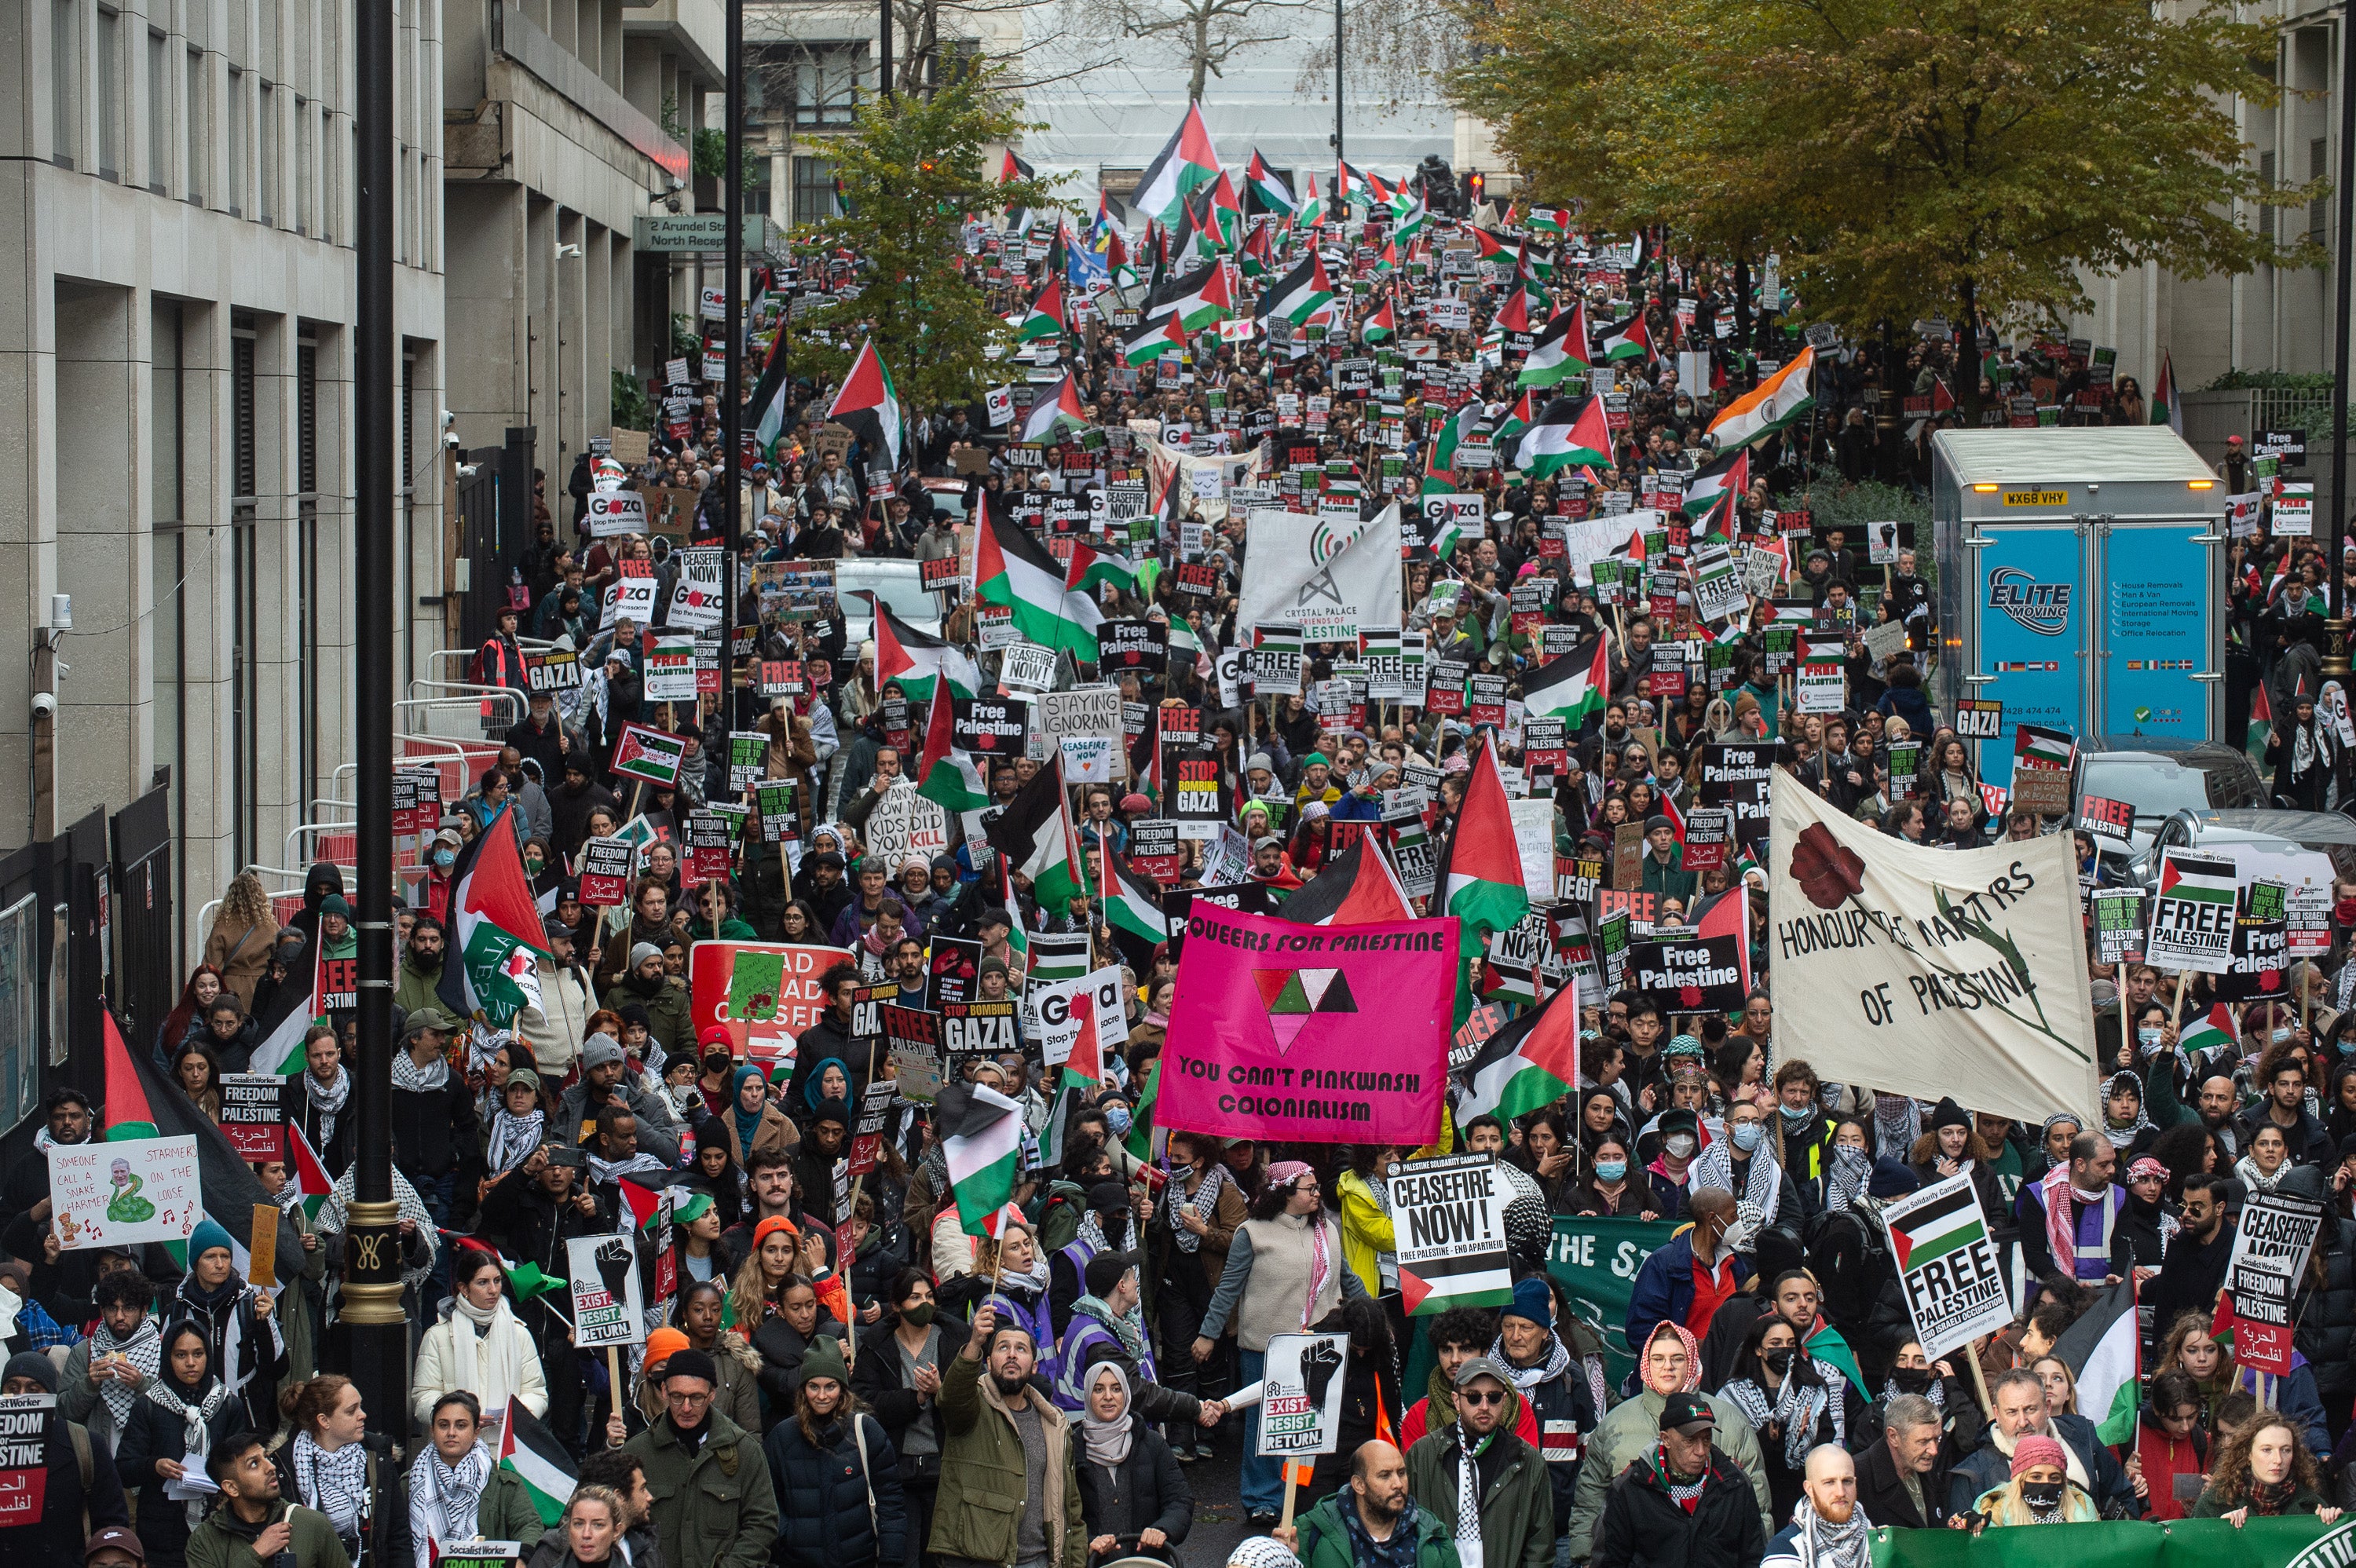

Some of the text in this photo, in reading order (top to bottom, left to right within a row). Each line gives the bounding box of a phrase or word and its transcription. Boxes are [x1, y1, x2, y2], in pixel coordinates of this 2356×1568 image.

[651, 221, 746, 232] 2 Arundel Strt
[652, 236, 744, 247] North Recepn
[1115, 314, 1138, 326] GAZA
[672, 386, 693, 395] Free
[663, 396, 702, 406] Palestine
[1904, 397, 1930, 410] FREE
[2267, 433, 2292, 443] Free
[1010, 448, 1043, 466] GAZA
[2254, 442, 2304, 455] Palestine
[1063, 454, 1092, 470] FREE
[1063, 469, 1092, 477] PALESTINE
[1107, 492, 1145, 503] CEASEFIRE
[2008, 492, 2063, 504] WX68 VHY
[1110, 503, 1141, 518] NOW!
[923, 557, 960, 580] FREE
[1178, 563, 1216, 587] FREE
[925, 576, 960, 590] PALESTINE
[1176, 581, 1213, 595] PALESTINE
[1989, 583, 2072, 607] ELITE
[1286, 607, 1357, 618] CRYSTAL PALACE
[2010, 606, 2067, 618] MOVING
[2173, 609, 2199, 619] Moving
[1115, 624, 1147, 638] Free
[1100, 638, 1163, 656] Palestine
[1008, 646, 1054, 668] CEASEFIRE
[762, 661, 803, 683] FREE
[1009, 660, 1048, 684] NOW!
[763, 682, 803, 693] PALESTINE
[971, 702, 1006, 719] Free
[1046, 693, 1118, 715] STAYING
[1958, 700, 2000, 711] STOP BOMBING
[2026, 707, 2042, 715] 474
[2044, 707, 2061, 715] 474
[956, 718, 1022, 736] Palestine
[1044, 713, 1118, 733] IGNORANT
[1956, 710, 1999, 736] GAZA
[1062, 742, 1107, 751] CEASEFIRE
[1077, 751, 1098, 760] NOW
[1179, 760, 1217, 780] STOP
[760, 787, 792, 798] FROM THE
[1179, 780, 1217, 791] BOMBING
[761, 796, 790, 806] RIVER TO
[1178, 791, 1218, 812] GAZA
[761, 806, 788, 815] THE SEA
[763, 813, 797, 824] PALESTINE
[871, 802, 902, 818] HOW
[2082, 794, 2131, 827] FREE
[763, 823, 789, 832] WILL BE
[870, 814, 942, 837] KIDS DID
[2080, 816, 2127, 839] PALESTINE
[765, 832, 780, 842] FREE
[872, 830, 946, 854] YOU KILL
[591, 846, 627, 860] FREEDOM
[586, 862, 627, 876] PALESTINE
[591, 878, 617, 890] الحرية
[585, 889, 620, 900] لفلسطين
[1779, 861, 2035, 959] HONOUR THE MARTYRS
[2155, 898, 2233, 935] FREE
[1189, 916, 1444, 952] QUEERS FOR PALESTINE
[2153, 927, 2230, 948] PALESTINE
[1663, 946, 1710, 967] Free
[2166, 945, 2190, 954] ISRAELI
[2190, 948, 2226, 958] OCCUPATION
[1640, 965, 1738, 990] Palestine
[1861, 967, 2036, 1027] OF PALESTINE
[944, 1002, 1012, 1018] STOP BOMBING
[945, 1018, 1016, 1052] GAZA
[229, 1076, 252, 1084] Socialist
[1179, 1055, 1420, 1093] YOU CAN'T PINKWASH
[225, 1086, 279, 1102] FREEDOM
[222, 1107, 281, 1122] PALESTINE
[1218, 1094, 1371, 1122] COLONIALISM
[232, 1128, 270, 1142] الحرية
[56, 1153, 98, 1170] SOMEONE
[145, 1145, 198, 1164] STARMER'S
[1403, 1153, 1488, 1173] PALESTINE SOLIDARITY CAMPAIGN
[57, 1171, 93, 1186] CALL A
[149, 1165, 192, 1184] ON THE
[65, 1182, 96, 1197] SNAKE
[157, 1186, 184, 1202] LOOSE
[1394, 1168, 1494, 1208] CEASEFIRE
[60, 1191, 110, 1212] CHARMER
[1886, 1177, 1970, 1222] Palestine Solidarity Campaign
[1408, 1198, 1491, 1248] NOW!
[1401, 1239, 1503, 1261] FREE PALESTINE END APARTHEID
[1904, 1239, 1996, 1311] FREE
[2238, 1269, 2285, 1296] FREEDOM
[1915, 1275, 2001, 1330] PALESTINE
[2255, 1291, 2264, 1301] for
[1922, 1294, 2003, 1341] END ISRAELI OCCUPATION
[2235, 1298, 2287, 1324] PALESTINE
[2243, 1324, 2277, 1343] الحرية
[2239, 1342, 2282, 1362] لفلسطين
[1268, 1397, 1310, 1414] EXIST.
[1267, 1414, 1315, 1433] RESIST.
[1267, 1430, 1322, 1449] RETURN.
